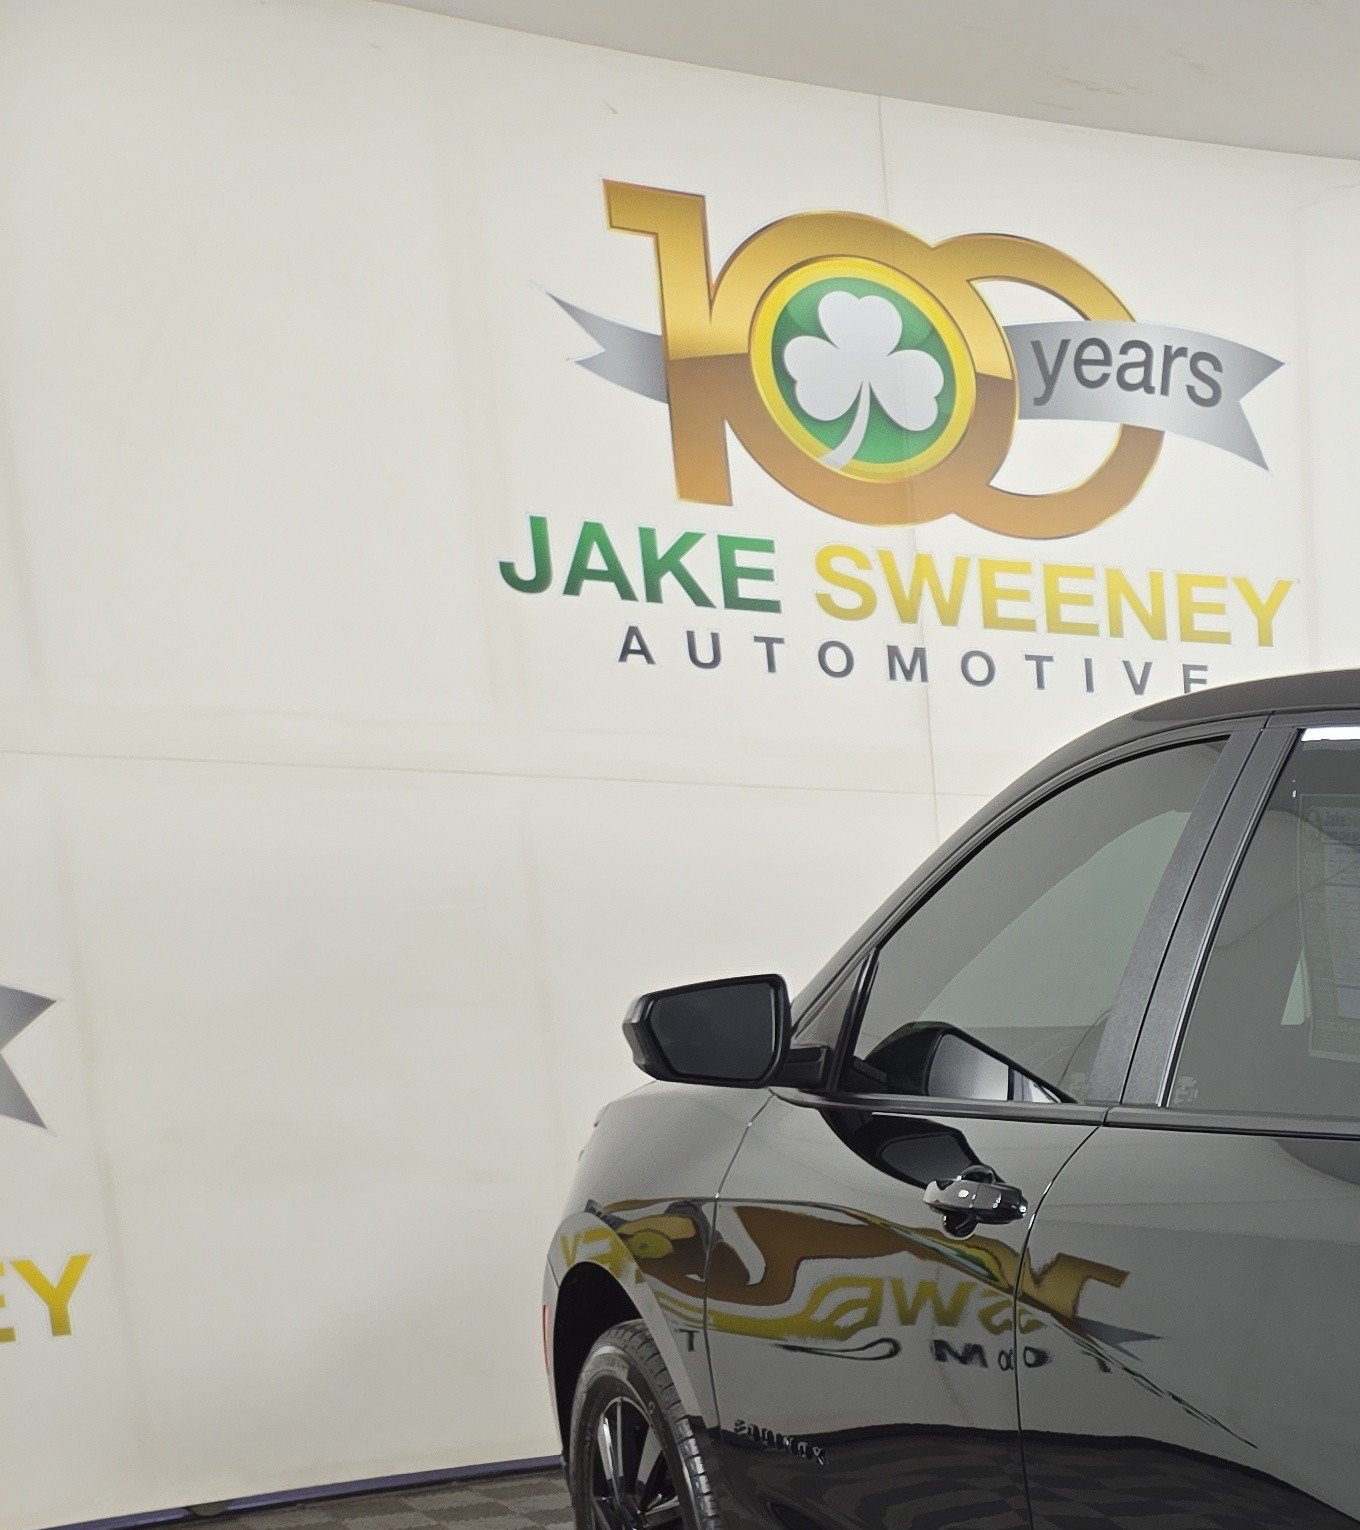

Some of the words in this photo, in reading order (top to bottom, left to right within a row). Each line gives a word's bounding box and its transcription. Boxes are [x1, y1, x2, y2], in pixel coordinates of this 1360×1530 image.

[603, 179, 1166, 538] 100
[1031, 337, 1224, 408] years
[499, 514, 781, 613] JAKE
[814, 544, 1294, 647] SWEENEY
[619, 626, 1208, 694] AUTOMOTIVE
